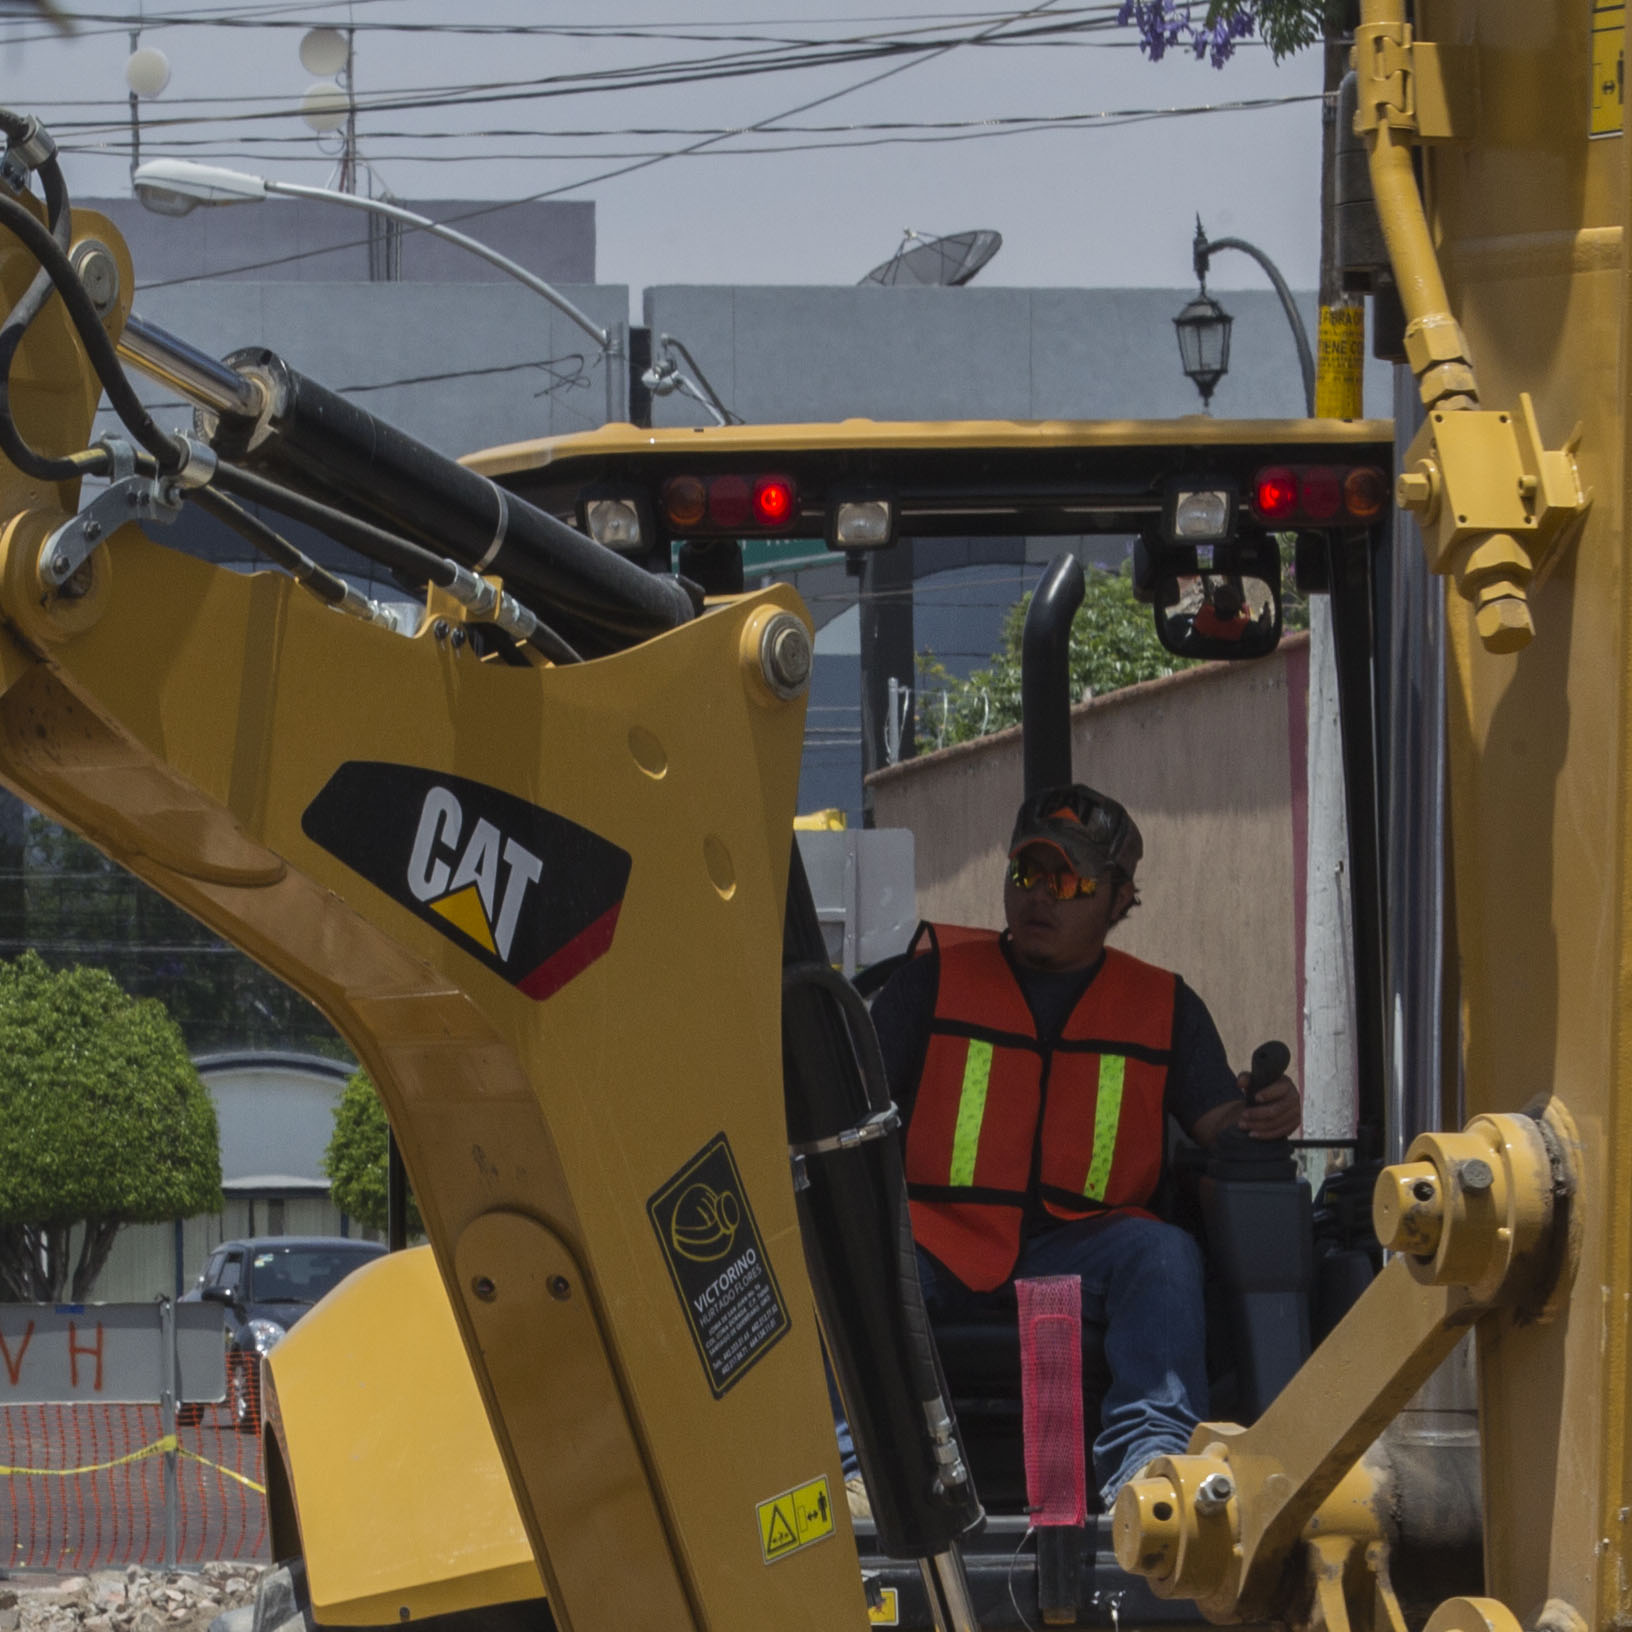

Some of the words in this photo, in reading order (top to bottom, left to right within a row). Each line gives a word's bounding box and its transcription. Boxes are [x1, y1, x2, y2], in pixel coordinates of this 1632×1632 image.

[407, 786, 544, 963] CAT
[694, 1248, 757, 1313] VICTORINO
[699, 1288, 736, 1328] HURTADO
[734, 1263, 762, 1294] FLORES
[68, 1319, 105, 1391] H
